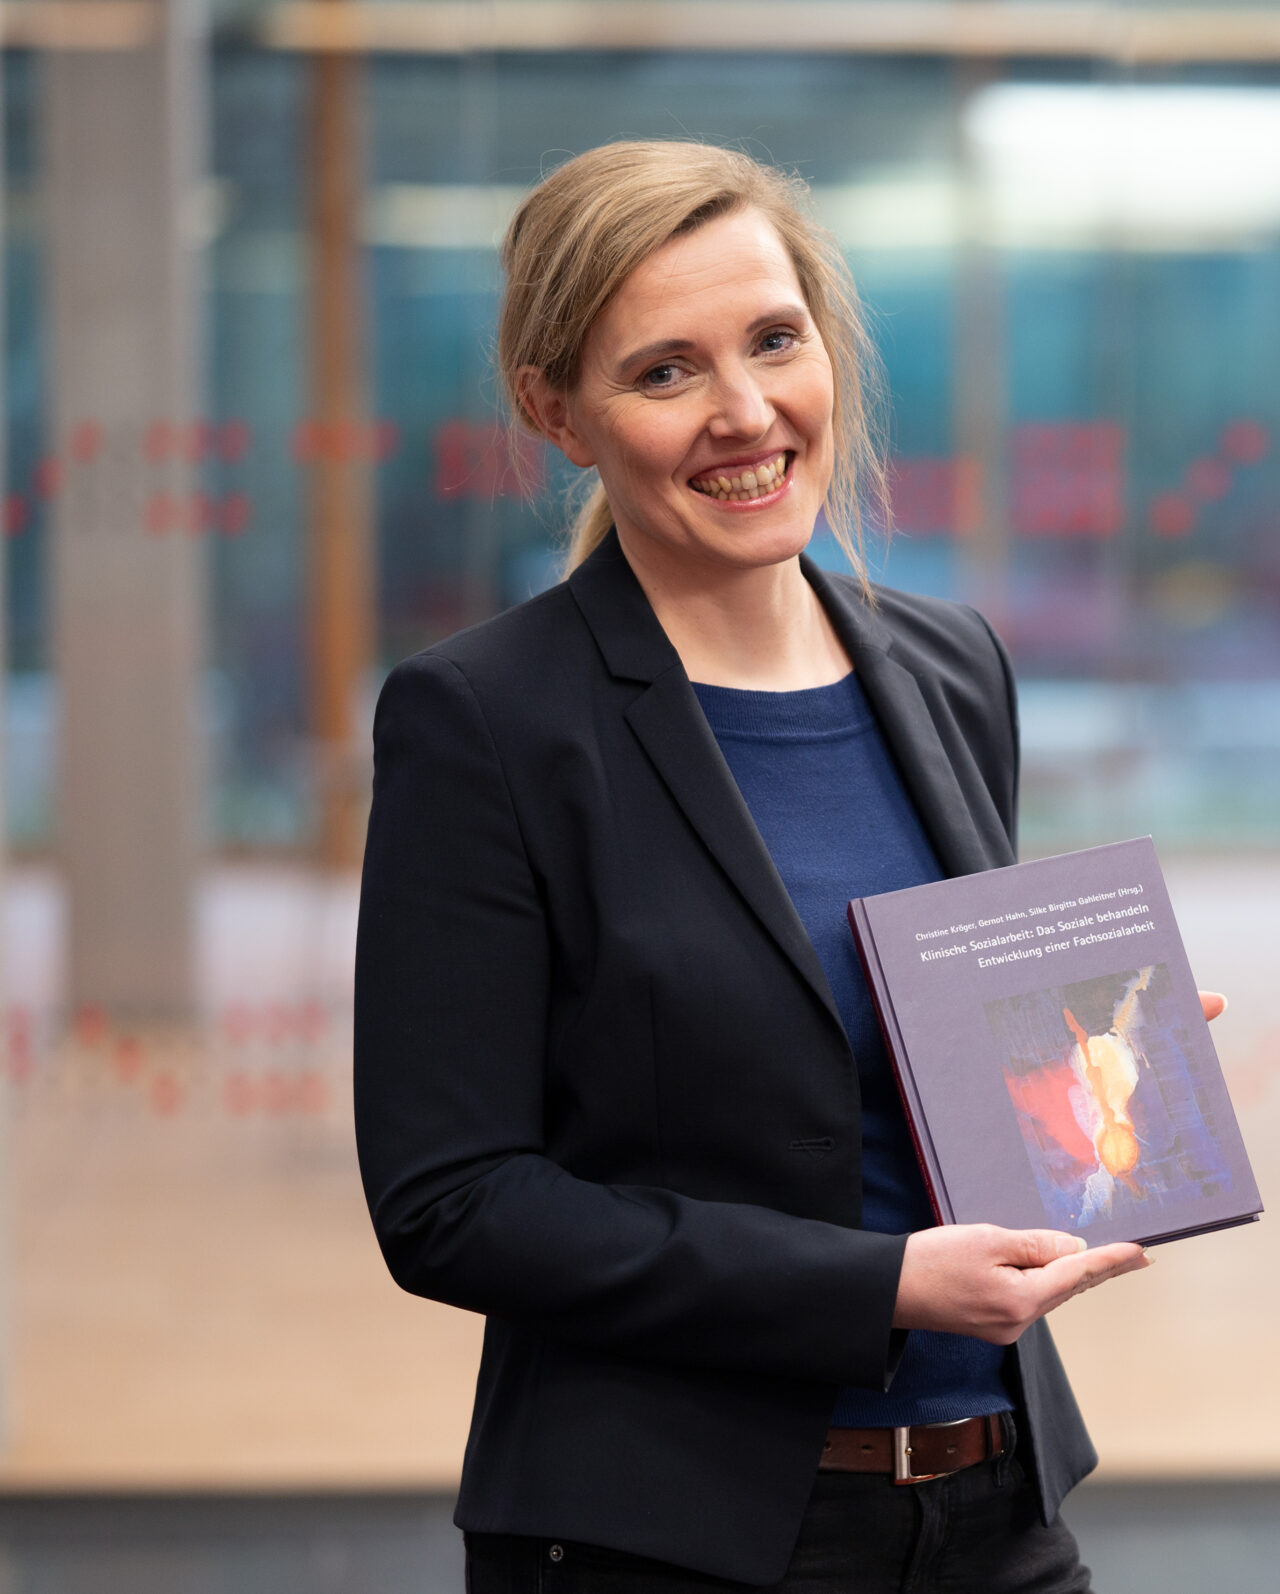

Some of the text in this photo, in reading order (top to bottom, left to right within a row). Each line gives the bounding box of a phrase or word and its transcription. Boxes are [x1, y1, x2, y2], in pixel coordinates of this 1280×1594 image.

[915, 884, 1143, 941] Christine Kröger, Gernot Hahn, Silke Birgitta Gahleitner (Hrsg.)
[920, 904, 1149, 962] Klinische Sozialarbeit: Das Soziale behandeln
[978, 920, 1155, 968] Entwicklung einer Fachsozialarbeit
